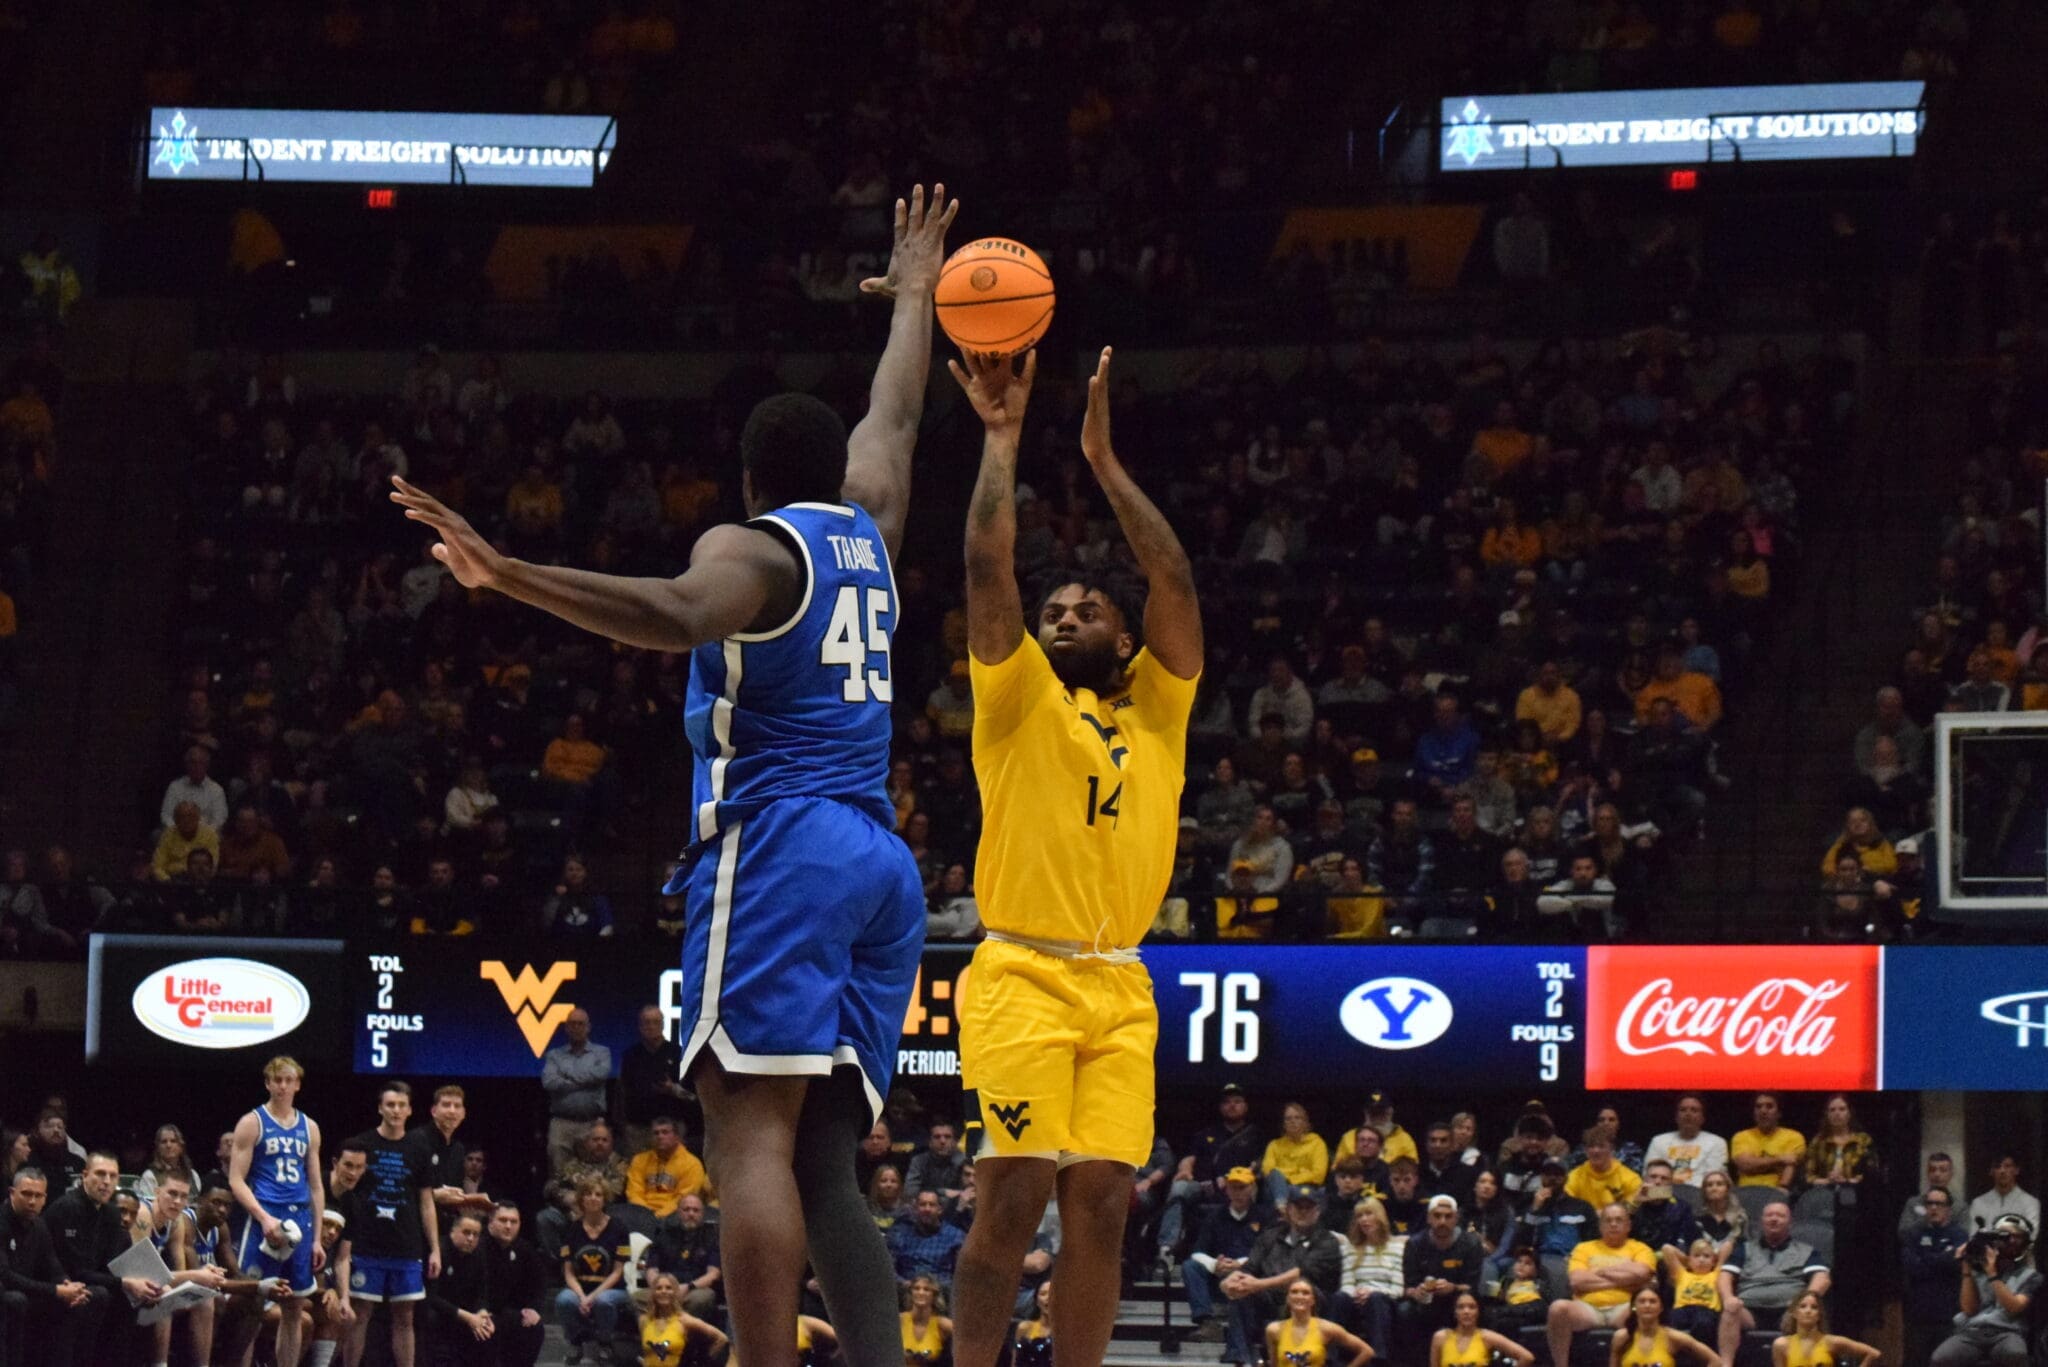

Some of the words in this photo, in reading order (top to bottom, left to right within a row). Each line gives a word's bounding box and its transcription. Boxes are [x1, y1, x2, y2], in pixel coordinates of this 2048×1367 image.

[1757, 111, 1918, 139] SOLUTIONS
[206, 138, 327, 161] TRDENT
[331, 140, 451, 164] FREIGHT
[821, 586, 893, 703] 45
[1087, 775, 1122, 831] 14
[369, 955, 404, 972] TOL
[1537, 963, 1575, 979] TOL
[165, 976, 221, 1004] Little
[378, 973, 393, 1009] 2
[1545, 980, 1563, 1018] 2
[178, 997, 272, 1028] General
[367, 1014, 424, 1031] FOULS
[1179, 972, 1260, 1063] 76
[1361, 986, 1433, 1041] Y
[1616, 978, 1850, 1056] Coca-Cola
[1511, 1025, 1574, 1041] FOULS
[372, 1031, 388, 1068] 5
[897, 1050, 961, 1075] PERIOD:
[1540, 1043, 1559, 1081] 9
[265, 1136, 307, 1158] BYU
[275, 1157, 300, 1184] 15
